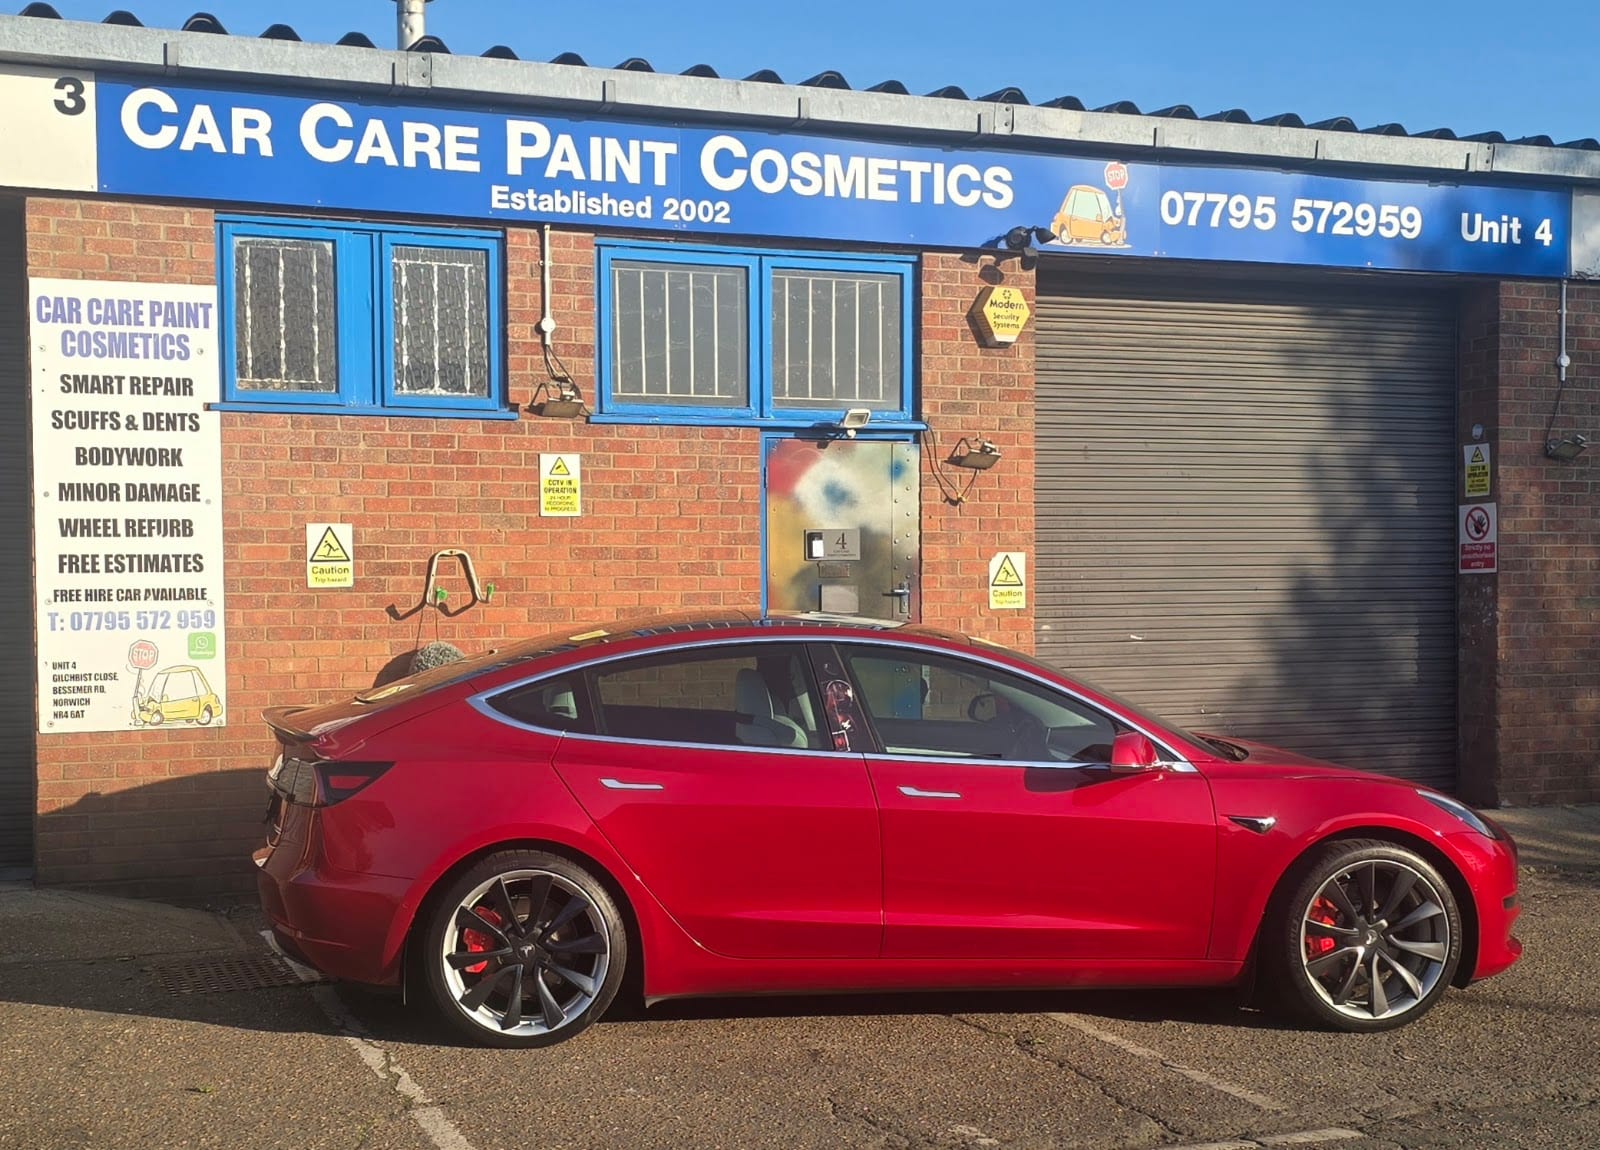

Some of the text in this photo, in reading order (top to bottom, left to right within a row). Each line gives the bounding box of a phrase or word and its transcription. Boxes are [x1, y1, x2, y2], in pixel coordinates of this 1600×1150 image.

[54, 77, 85, 115] 3
[121, 88, 1013, 209] CAR CARE PAINT COSMETICS
[491, 185, 731, 224] Established 2002
[1160, 190, 1422, 239] 07795 572959
[1460, 212, 1553, 246] Unit 4
[36, 295, 212, 329] CAR CARE PAINT
[990, 299, 1025, 310] Modern
[993, 313, 1020, 322] Security
[993, 322, 1020, 330] Systems
[61, 330, 190, 361] COSMETICS
[60, 374, 194, 396] SMART REPAIR
[51, 410, 200, 432] SCUFFS & DENTS
[75, 447, 183, 467] BODYWORK
[58, 483, 201, 503] MINOR DAMAGE
[58, 518, 194, 538] WHEEL REFURB
[835, 532, 848, 549] 4
[58, 553, 204, 573] FREE ESTIMATES
[311, 566, 350, 575] Caution
[53, 588, 207, 602] FREE HIRE CAR AVAILABLE
[992, 589, 1023, 598] Caution
[48, 609, 216, 631] T: 07795 572 959
[52, 661, 77, 670] UNIT 4
[52, 685, 92, 695] BESSEMER
[53, 698, 91, 707] NORWICH
